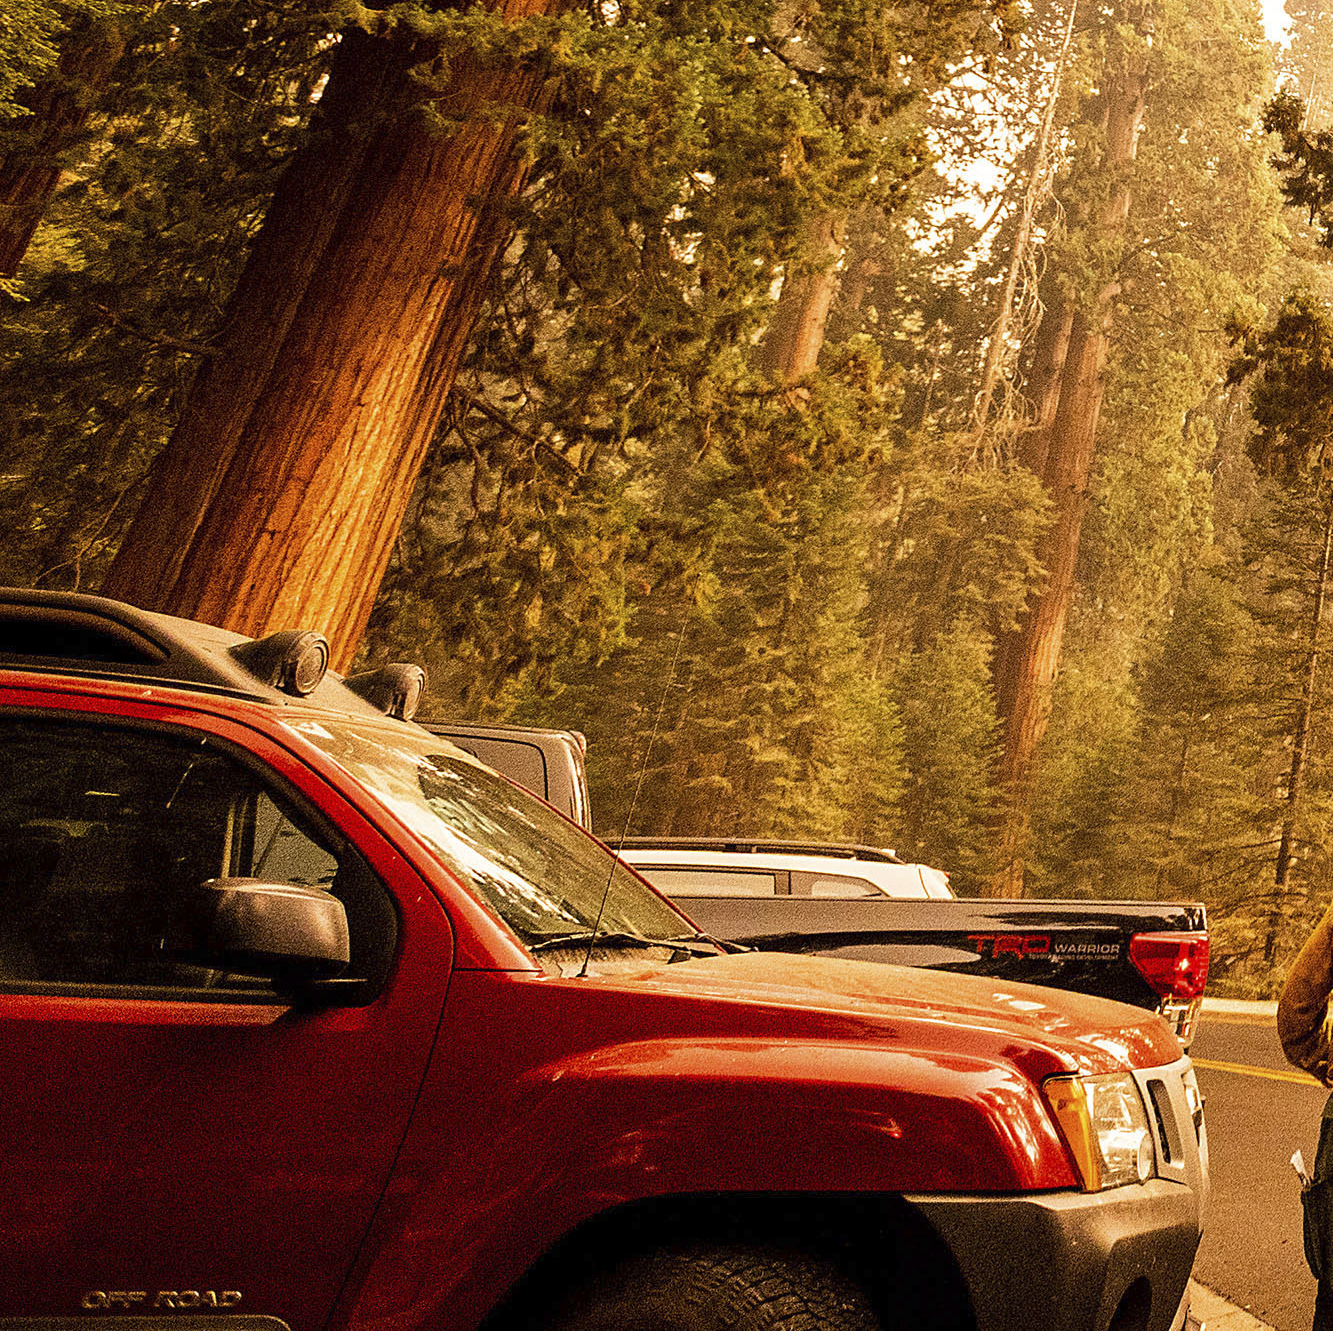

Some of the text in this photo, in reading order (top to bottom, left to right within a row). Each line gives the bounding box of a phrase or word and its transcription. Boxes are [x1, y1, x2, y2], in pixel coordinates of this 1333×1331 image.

[967, 934, 1120, 959] TRD WARRIOR
[81, 1290, 242, 1309] OFF ROAD
